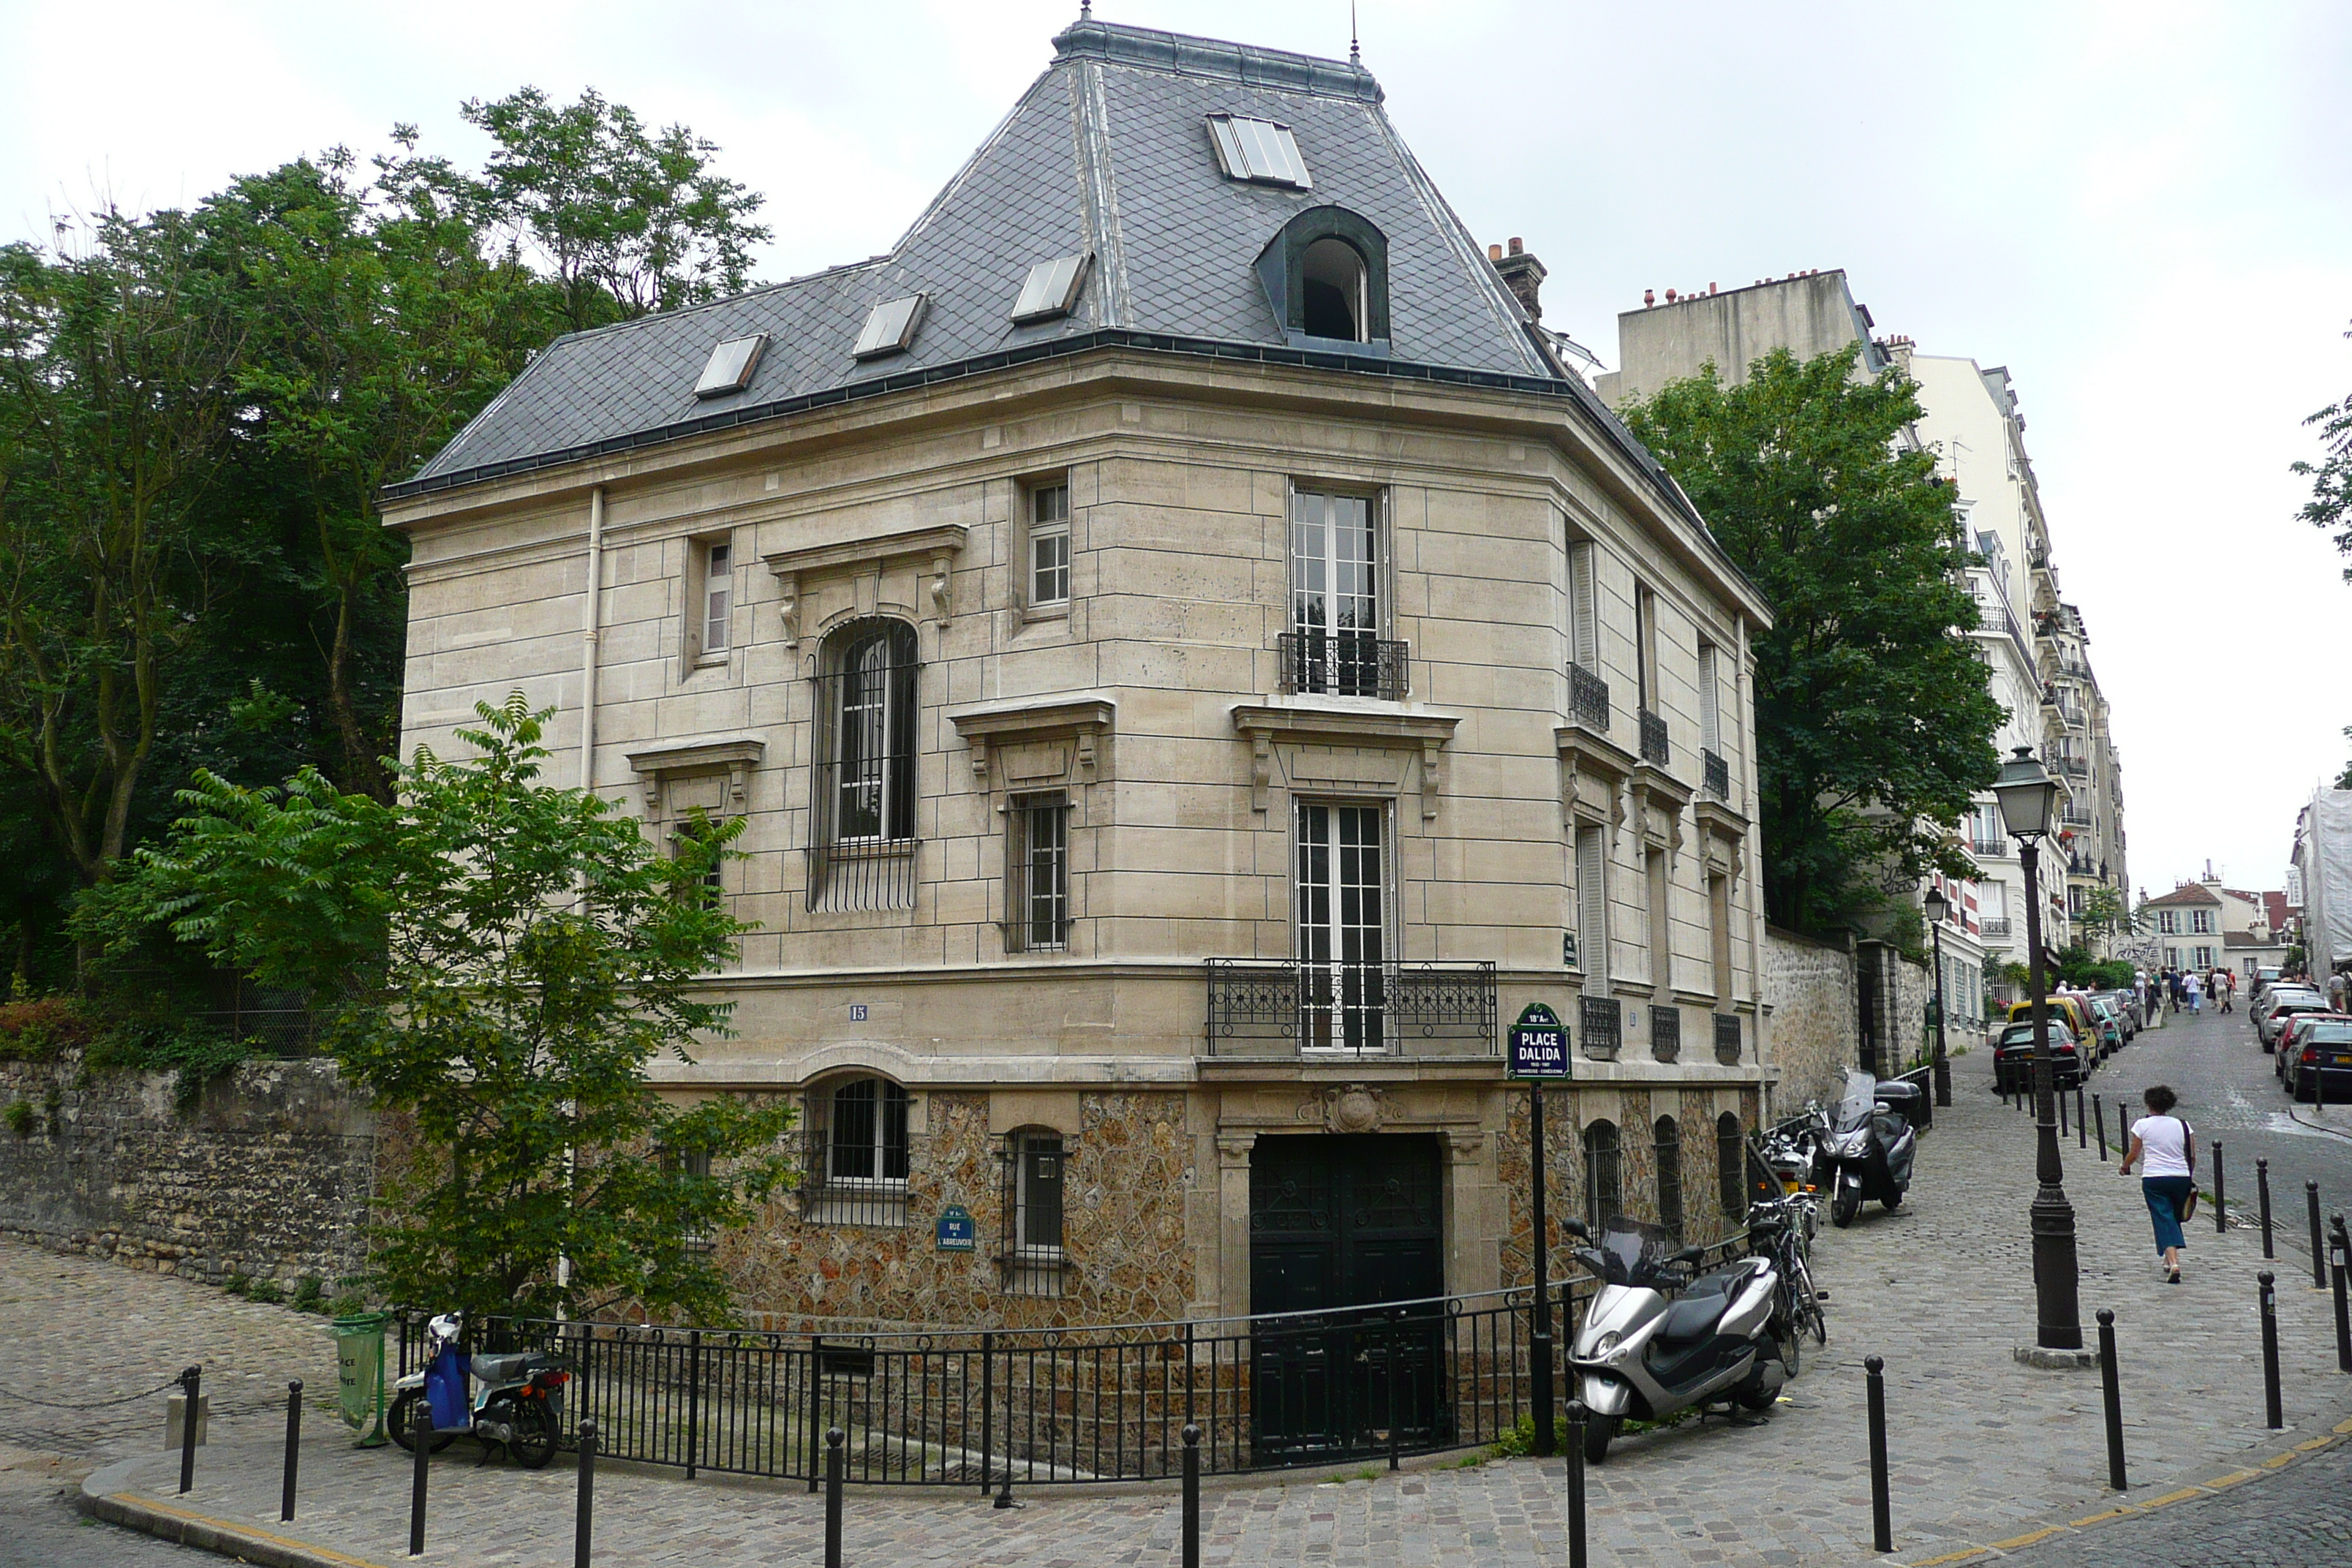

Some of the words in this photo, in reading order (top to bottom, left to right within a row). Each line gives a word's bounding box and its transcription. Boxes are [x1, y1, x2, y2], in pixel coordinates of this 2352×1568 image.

[853, 1006, 864, 1020] 15
[1522, 1032, 1558, 1046] PLACE
[1519, 1047, 1561, 1061] DALIDA
[949, 1223, 961, 1231] RUE
[938, 1237, 973, 1246] L'ABREUVOIR
